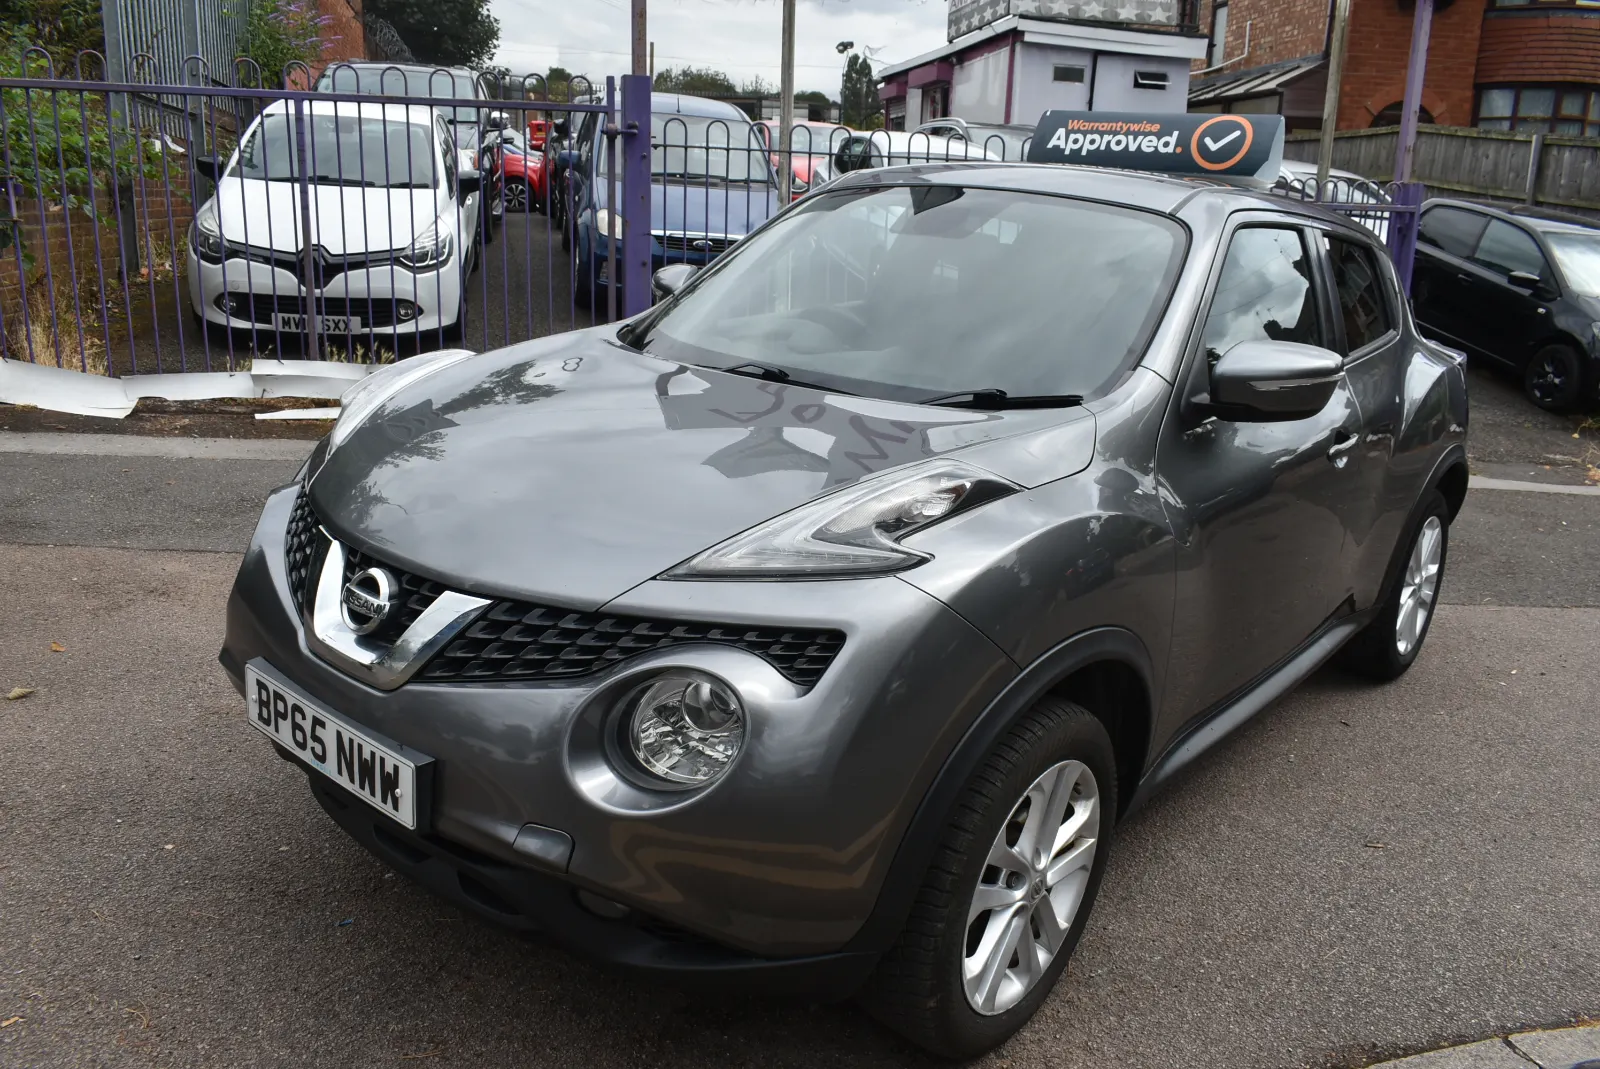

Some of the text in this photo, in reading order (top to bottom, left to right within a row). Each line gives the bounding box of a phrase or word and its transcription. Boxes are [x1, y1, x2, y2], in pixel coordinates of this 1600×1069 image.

[1068, 120, 1161, 133] Warrantywise
[1047, 127, 1183, 156] Approved.
[321, 318, 353, 332] SXX
[256, 678, 400, 812] BP65 NWW
